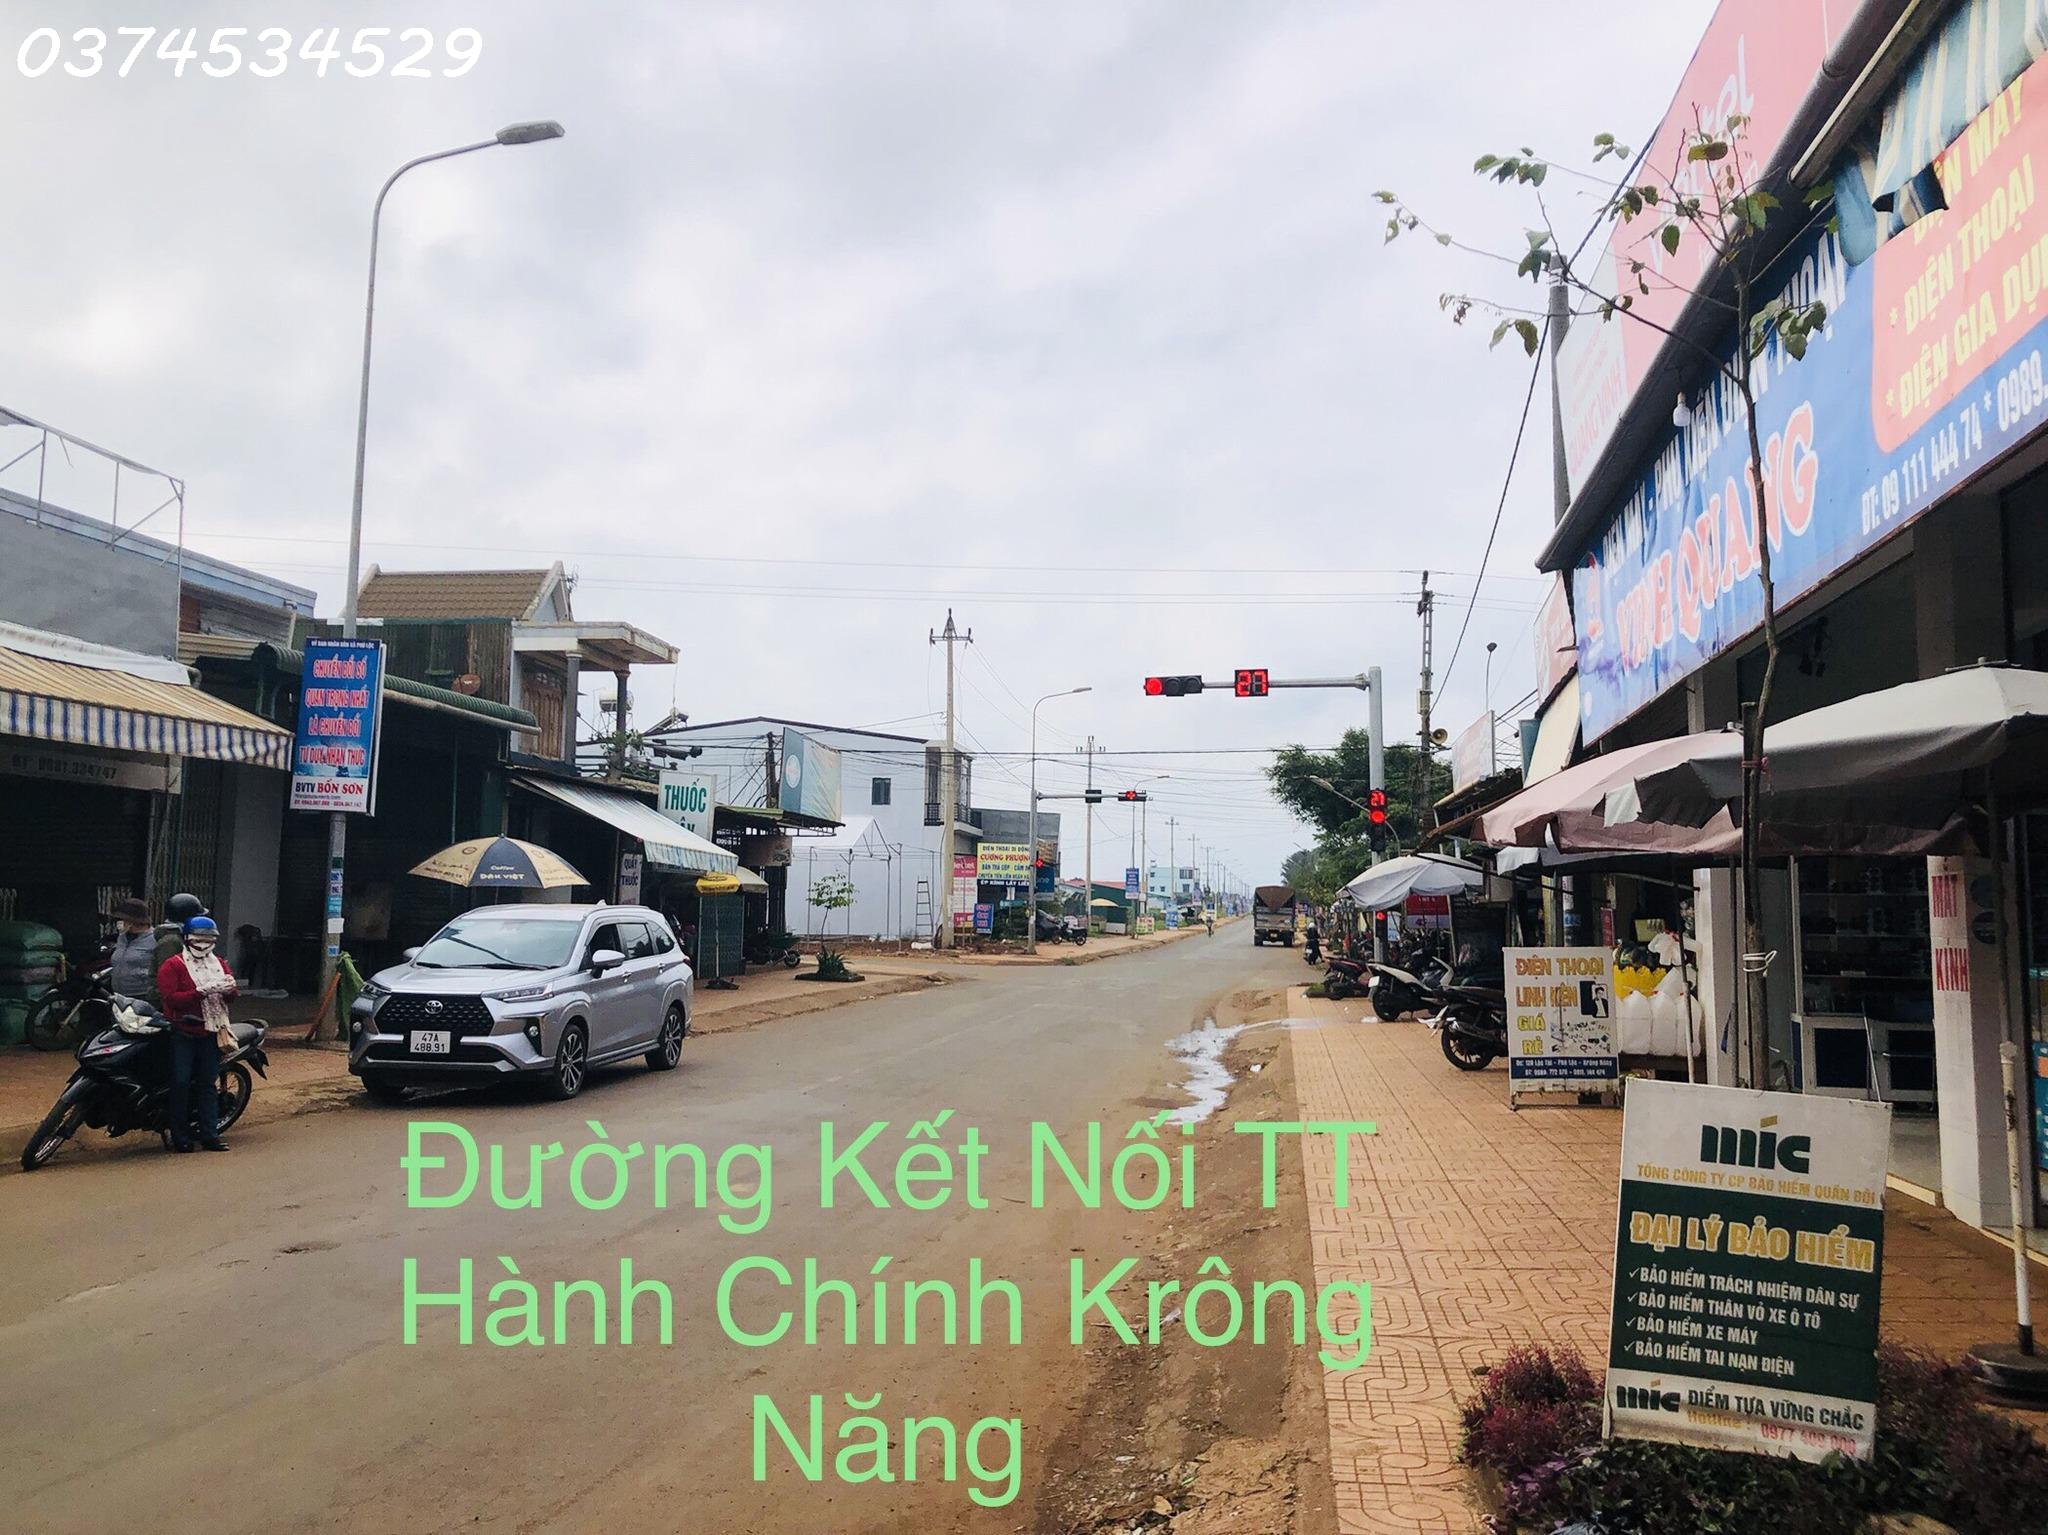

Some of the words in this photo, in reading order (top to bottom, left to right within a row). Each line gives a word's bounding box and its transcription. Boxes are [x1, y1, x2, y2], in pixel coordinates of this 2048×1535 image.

[1904, 244, 1955, 336] ĐIỆN
[1958, 153, 2035, 273] THOẠI
[1899, 333, 1949, 420] ĐIỆN
[1954, 290, 1997, 368] GIA
[1881, 468, 1900, 521] 09
[1901, 446, 1928, 506] 111
[1930, 421, 1960, 483] 444
[1960, 401, 1983, 460] 74
[1676, 399, 1819, 644] QUANG
[313, 653, 340, 679] CHUYỂN
[356, 655, 368, 680] SỐ
[1237, 671, 1266, 695] 27
[305, 688, 325, 708] QUAN
[326, 689, 349, 711] TRỌNG
[350, 684, 370, 708] NHẤT
[308, 714, 319, 736] LÀ
[320, 711, 347, 737] CHUYỂN
[295, 782, 316, 793] BVTV
[317, 778, 340, 794] BỐN
[342, 782, 364, 794] SƠN
[664, 777, 707, 813] THUỐC
[1515, 954, 1552, 980] ĐIỆN
[1556, 956, 1604, 980] THOẠI
[1934, 938, 1969, 993] KÍNH
[1516, 986, 1546, 1007] LINH
[1550, 981, 1578, 1012] KIỆN
[421, 1032, 438, 1042] 47A
[1517, 1012, 1546, 1031] GIÁ
[414, 1042, 445, 1052] 488.91
[1522, 1036, 1544, 1056] RẺ
[1637, 1162, 1670, 1180] TỔNG
[1672, 1165, 1707, 1184] CÔNG
[1728, 1174, 1746, 1189] CP
[1748, 1174, 1775, 1193] BẢO
[1777, 1177, 1811, 1198] HIỂM
[1814, 1183, 1850, 1203] QUÂN
[1852, 1187, 1876, 1205] ĐỘI
[1629, 1211, 1682, 1252] ĐẠI
[1685, 1213, 1724, 1252] LÝ
[1727, 1215, 1790, 1262] BẢO
[1795, 1223, 1876, 1273] HIỂM
[1640, 1263, 1668, 1284] BẢO
[1670, 1266, 1705, 1289] HIỂM
[1709, 1271, 1752, 1295] TRÁCH
[1756, 1279, 1802, 1303] NHIỆM
[1838, 1291, 1860, 1313] SỰ
[1638, 1289, 1666, 1309] BẢO
[1668, 1291, 1704, 1314] HIỂM
[1707, 1298, 1744, 1320] THÂN
[1746, 1302, 1765, 1322] VỎ
[1769, 1307, 1786, 1325] XE
[1790, 1307, 1800, 1327] Ô
[1803, 1309, 1821, 1330] TÔ
[1636, 1313, 1664, 1334] BẢO
[1667, 1315, 1703, 1339] HIỂM
[1706, 1324, 1724, 1341] XE
[1727, 1325, 1758, 1346] MÁY
[1635, 1338, 1662, 1359] BẢO
[1665, 1340, 1701, 1364] HIỂM
[1704, 1348, 1725, 1367] TAI
[1728, 1351, 1758, 1373] NẠN
[1761, 1354, 1796, 1378] ĐIỆN
[1687, 1384, 1730, 1411] ĐIỂM
[1734, 1394, 1768, 1418] TỰA
[1769, 1398, 1815, 1424] VỮNG
[1818, 1405, 1865, 1432] CHẮC
[1687, 1409, 1742, 1429] Hotline
[1760, 1423, 1795, 1441] 0977
